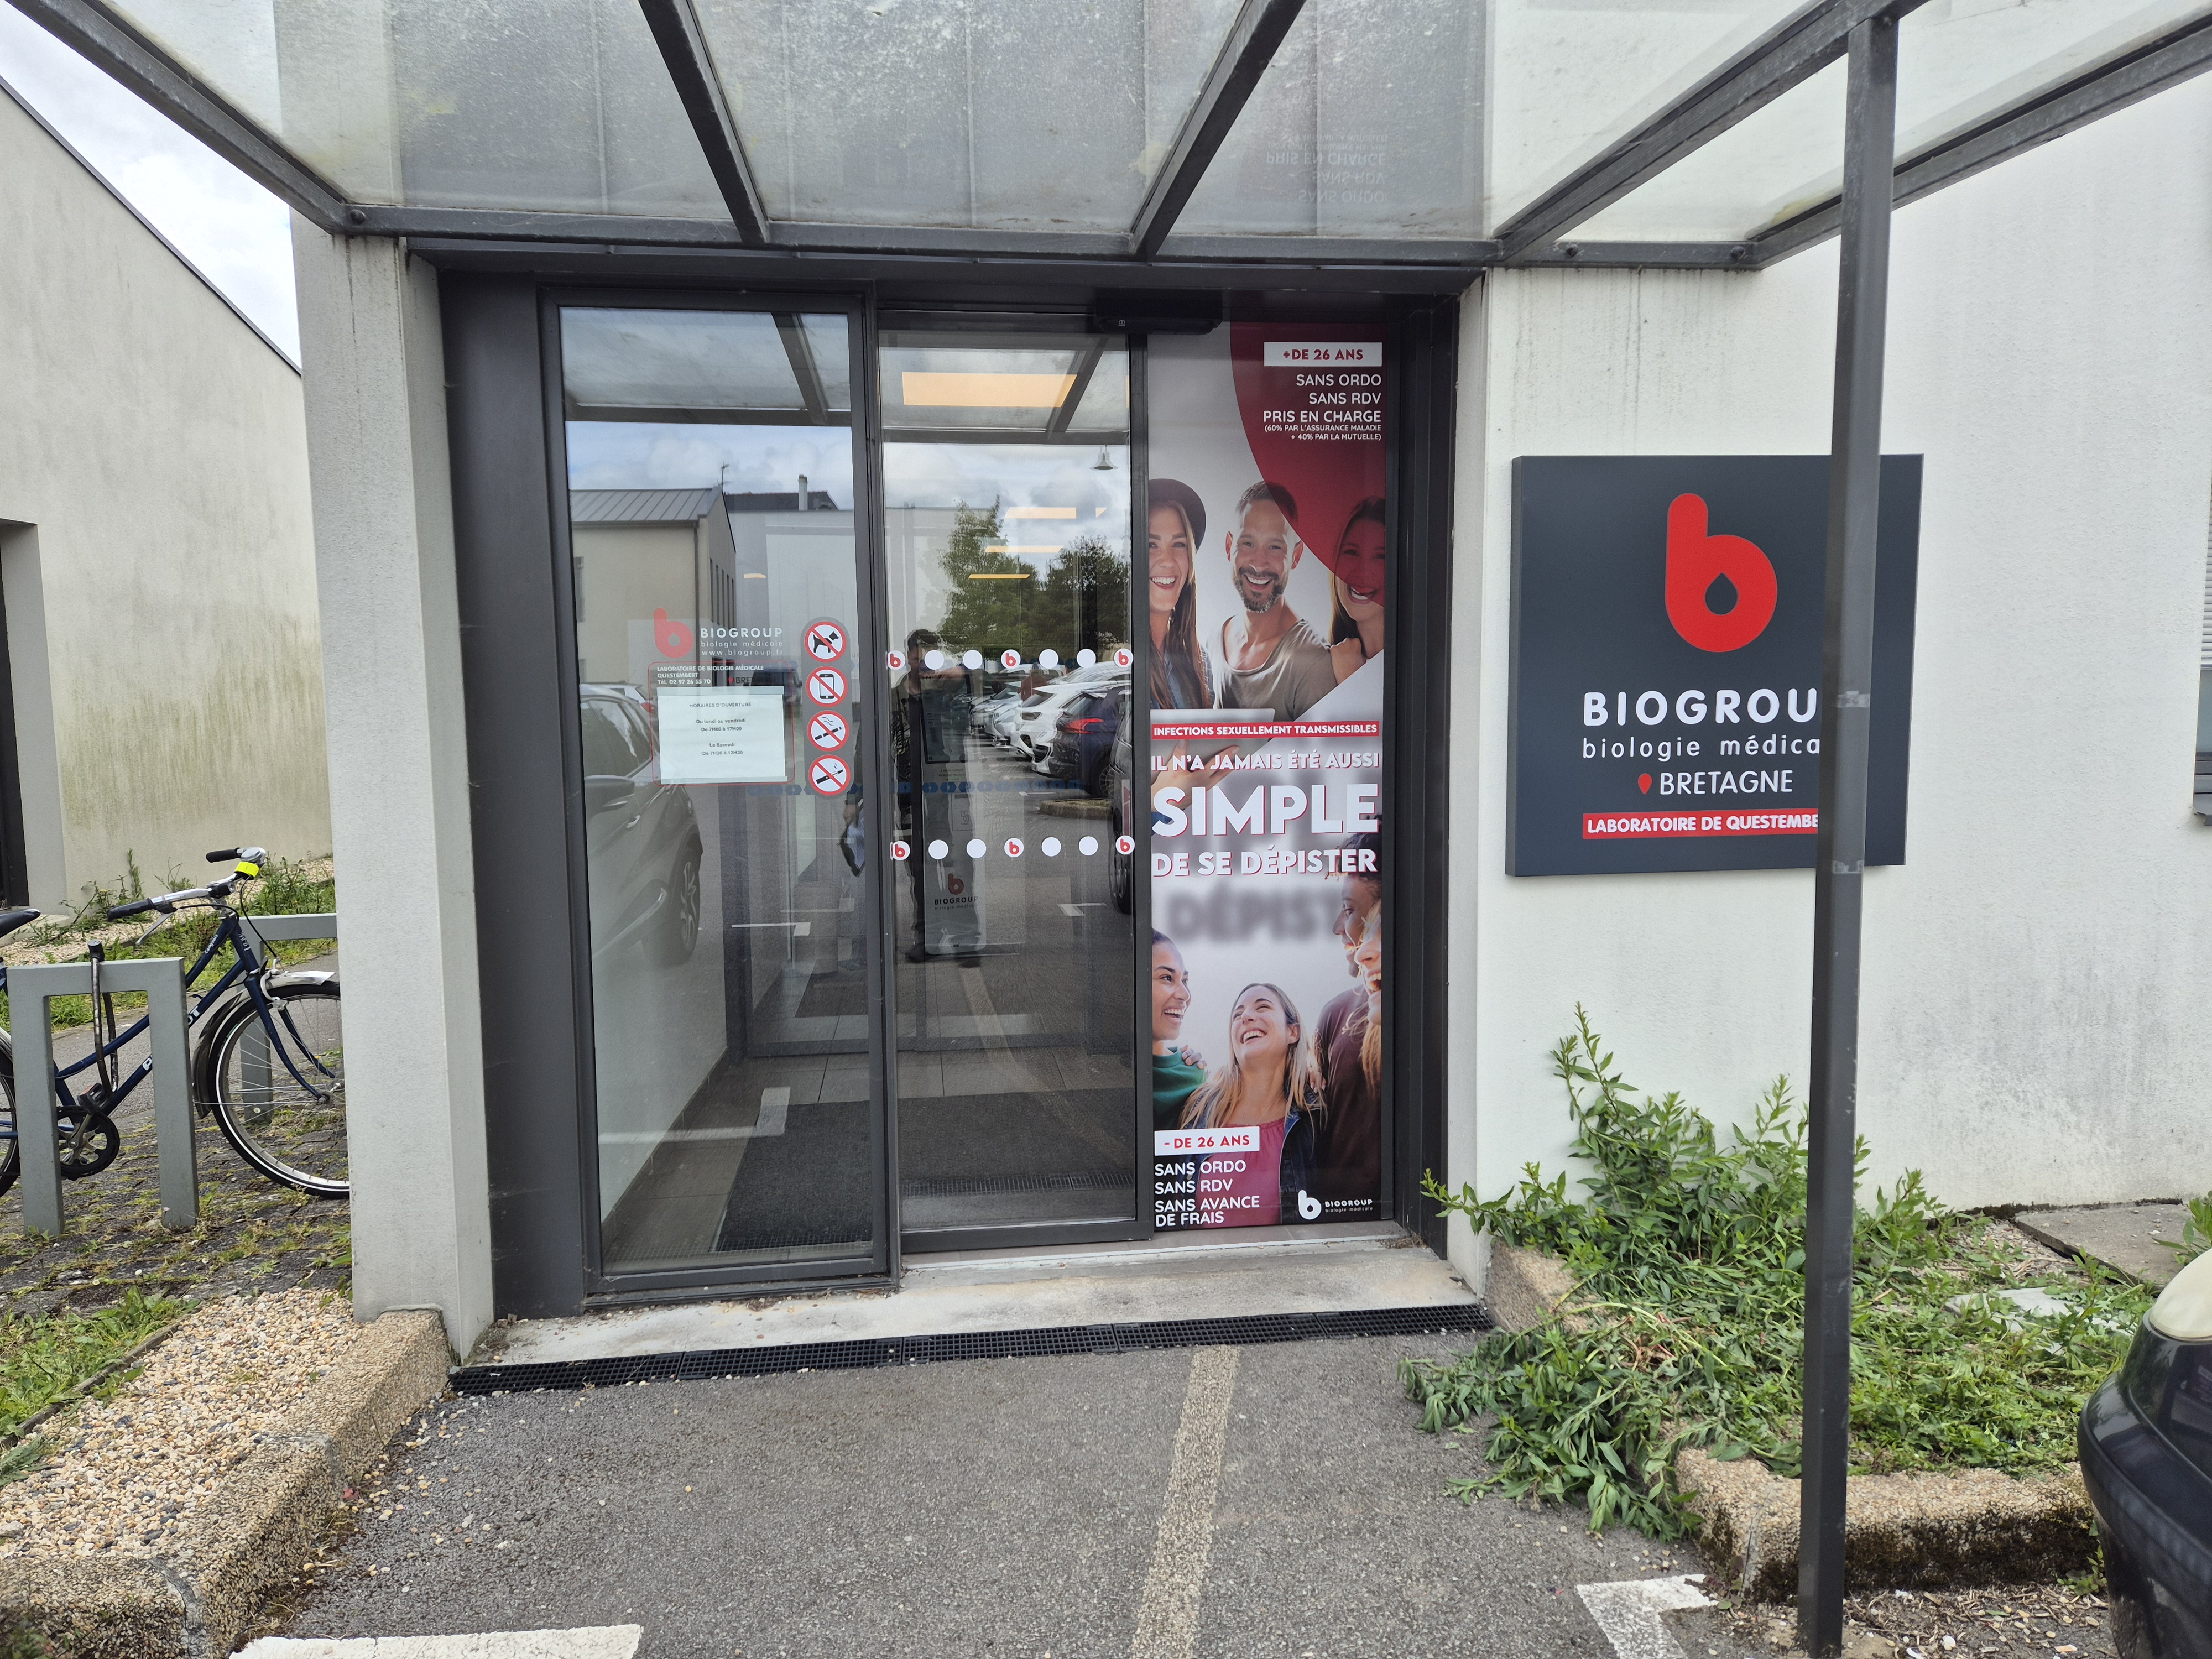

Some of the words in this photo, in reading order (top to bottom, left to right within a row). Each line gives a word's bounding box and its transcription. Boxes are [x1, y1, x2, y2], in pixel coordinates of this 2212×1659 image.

[1314, 349, 1330, 360] 26
[1335, 349, 1363, 360] ANS
[1296, 374, 1334, 386] SANS
[1339, 374, 1381, 386] ORDO
[1310, 393, 1346, 404] SANS
[1352, 393, 1381, 404] RDV
[1264, 411, 1295, 422] PRIS
[1301, 411, 1318, 422] EN
[1324, 410, 1381, 422] CHARGE
[701, 627, 782, 638] BIOGROUP
[1584, 688, 1817, 726] BIOGROU
[1154, 727, 1214, 735] INFECTIONS
[1217, 726, 1292, 734] SEXUELLEMENT
[1294, 724, 1377, 733] TRANSMISSIBLES
[1583, 737, 1699, 761] biologie
[1720, 734, 1820, 755] médica
[1151, 756, 1169, 771] IL
[1172, 754, 1204, 771] N'A
[1210, 753, 1284, 770] JAMAIS
[1287, 749, 1321, 769] ÉTÉ
[1324, 752, 1379, 768] AUSSI
[1661, 770, 1792, 795] BRETAGNE
[1152, 784, 1378, 837] SIMPLE
[1588, 817, 1696, 833] LABORATOIRE
[1702, 817, 1721, 830] DE
[1726, 814, 1818, 830] QUESTEMBE
[1152, 853, 1191, 878] DE
[1197, 851, 1234, 877] SE
[1240, 844, 1376, 875] DÉPISTER
[1175, 1138, 1192, 1149] DE
[1198, 1137, 1214, 1147] 26
[1221, 1135, 1250, 1146] ANS
[1155, 1162, 1195, 1177] SANS
[1200, 1160, 1246, 1173] ORDO
[1155, 1181, 1195, 1194] SANS
[1201, 1178, 1233, 1192] RDV
[1155, 1199, 1196, 1212] SANS
[1201, 1196, 1259, 1210] AVANCE
[1156, 1214, 1176, 1227] DE
[1181, 1211, 1224, 1225] FRAIS
